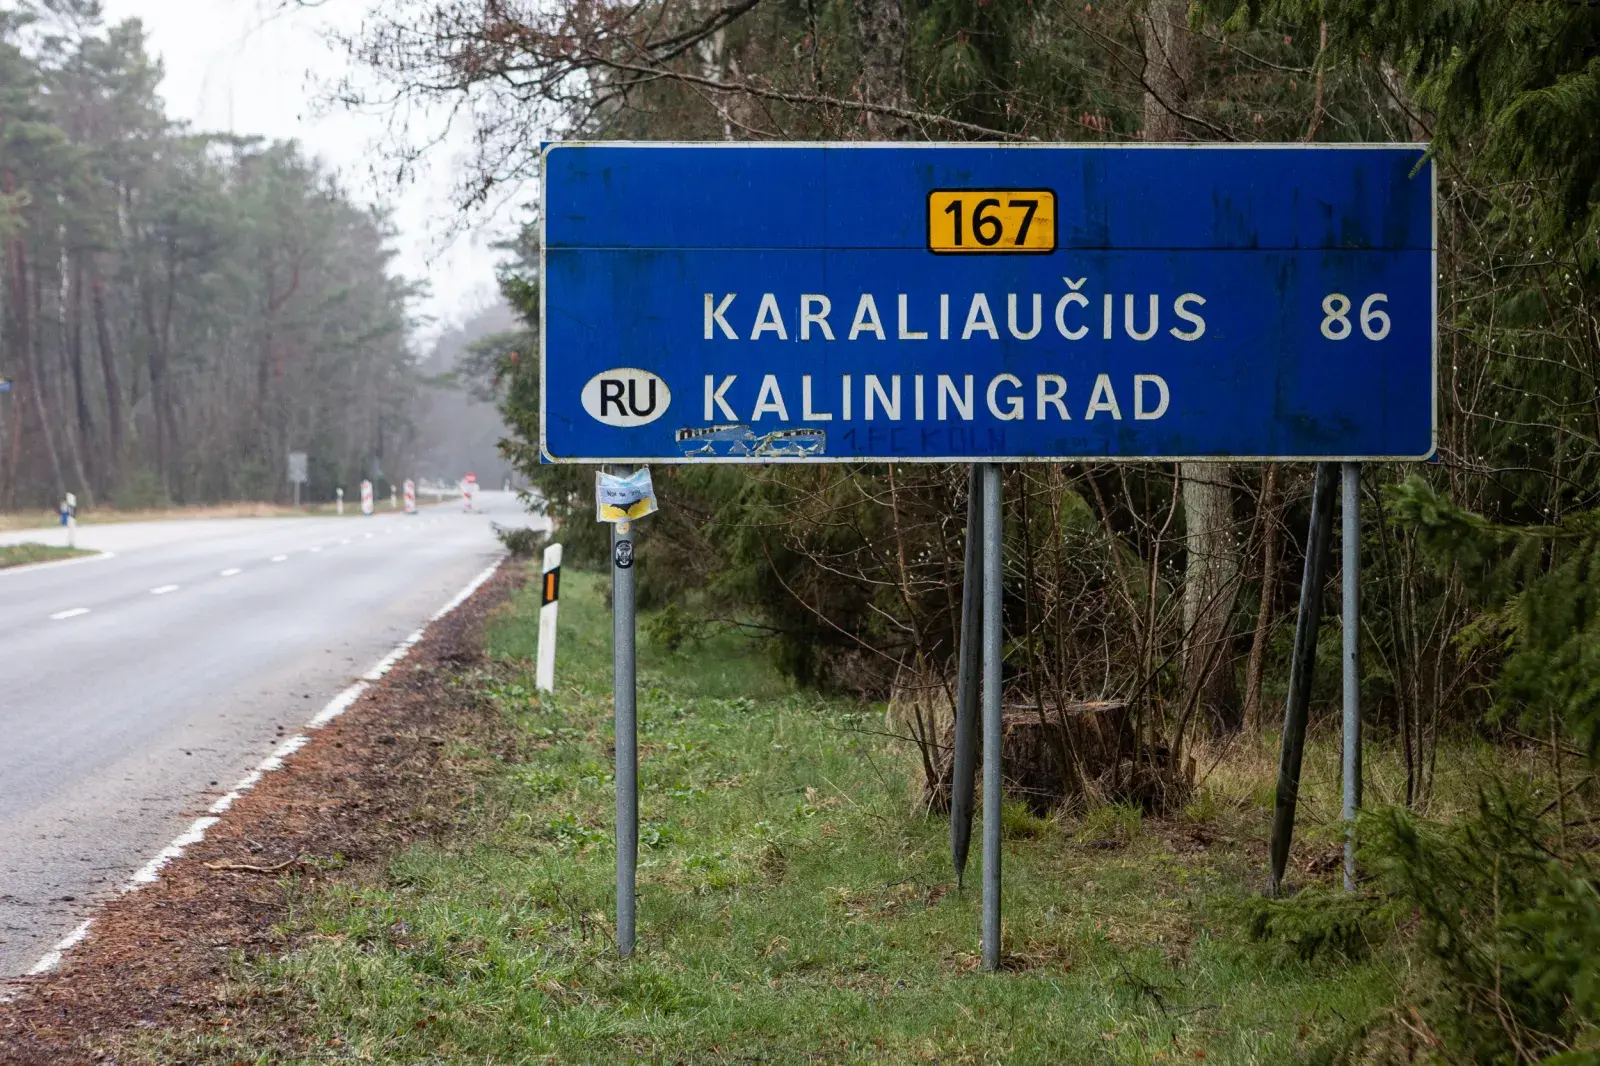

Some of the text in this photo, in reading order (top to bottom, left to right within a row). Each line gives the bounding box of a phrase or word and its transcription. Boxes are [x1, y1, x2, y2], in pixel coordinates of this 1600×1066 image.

[944, 198, 1038, 247] 167
[703, 277, 1392, 341] KARALIAUČIUS 86
[600, 379, 657, 417] RU
[704, 373, 1170, 421] KALININGRAD
